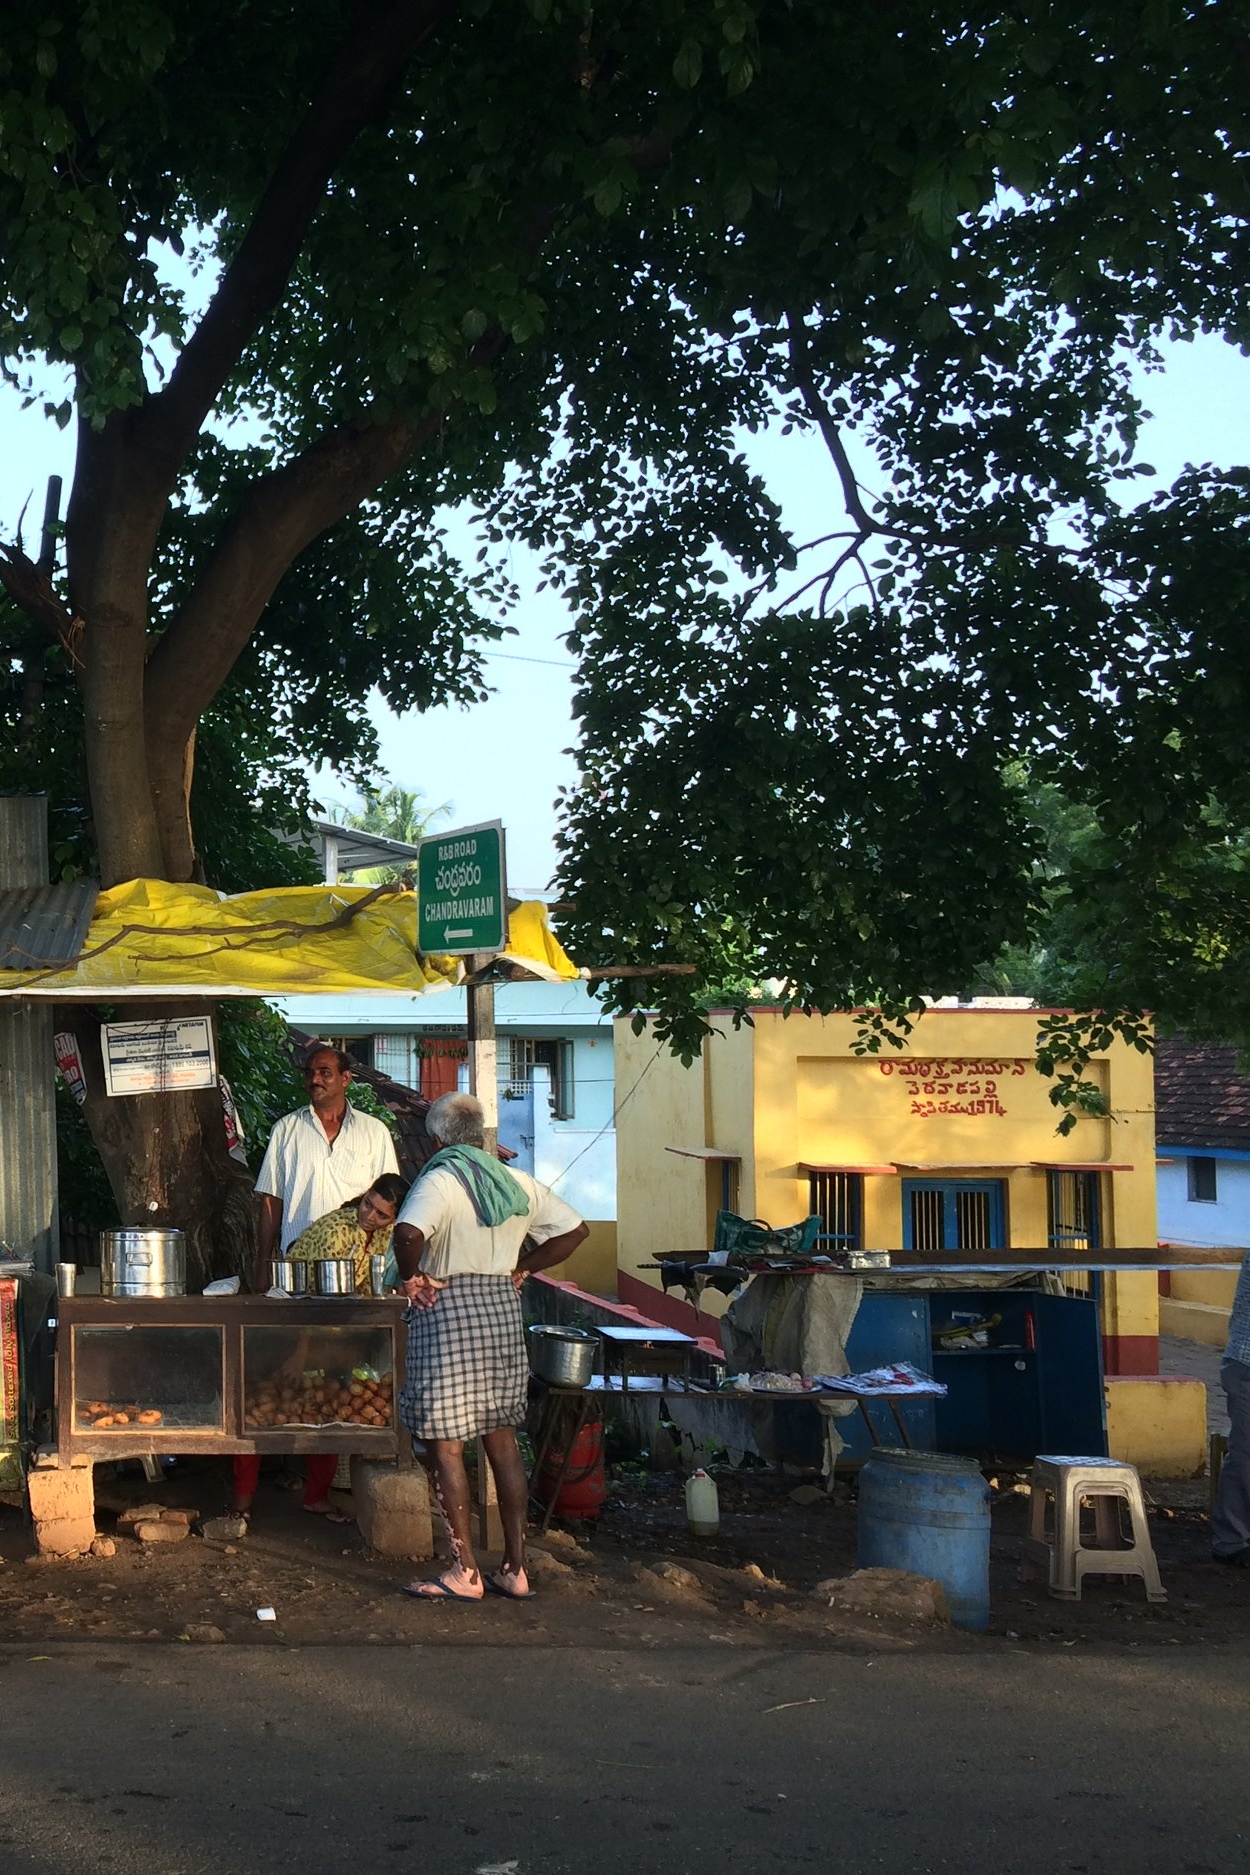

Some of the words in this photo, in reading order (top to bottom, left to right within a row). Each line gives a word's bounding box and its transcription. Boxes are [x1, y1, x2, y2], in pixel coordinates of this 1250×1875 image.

[455, 839, 477, 858] ROAD
[435, 861, 482, 897] చంద్రవరం
[425, 896, 494, 922] CHANDRAVARAM
